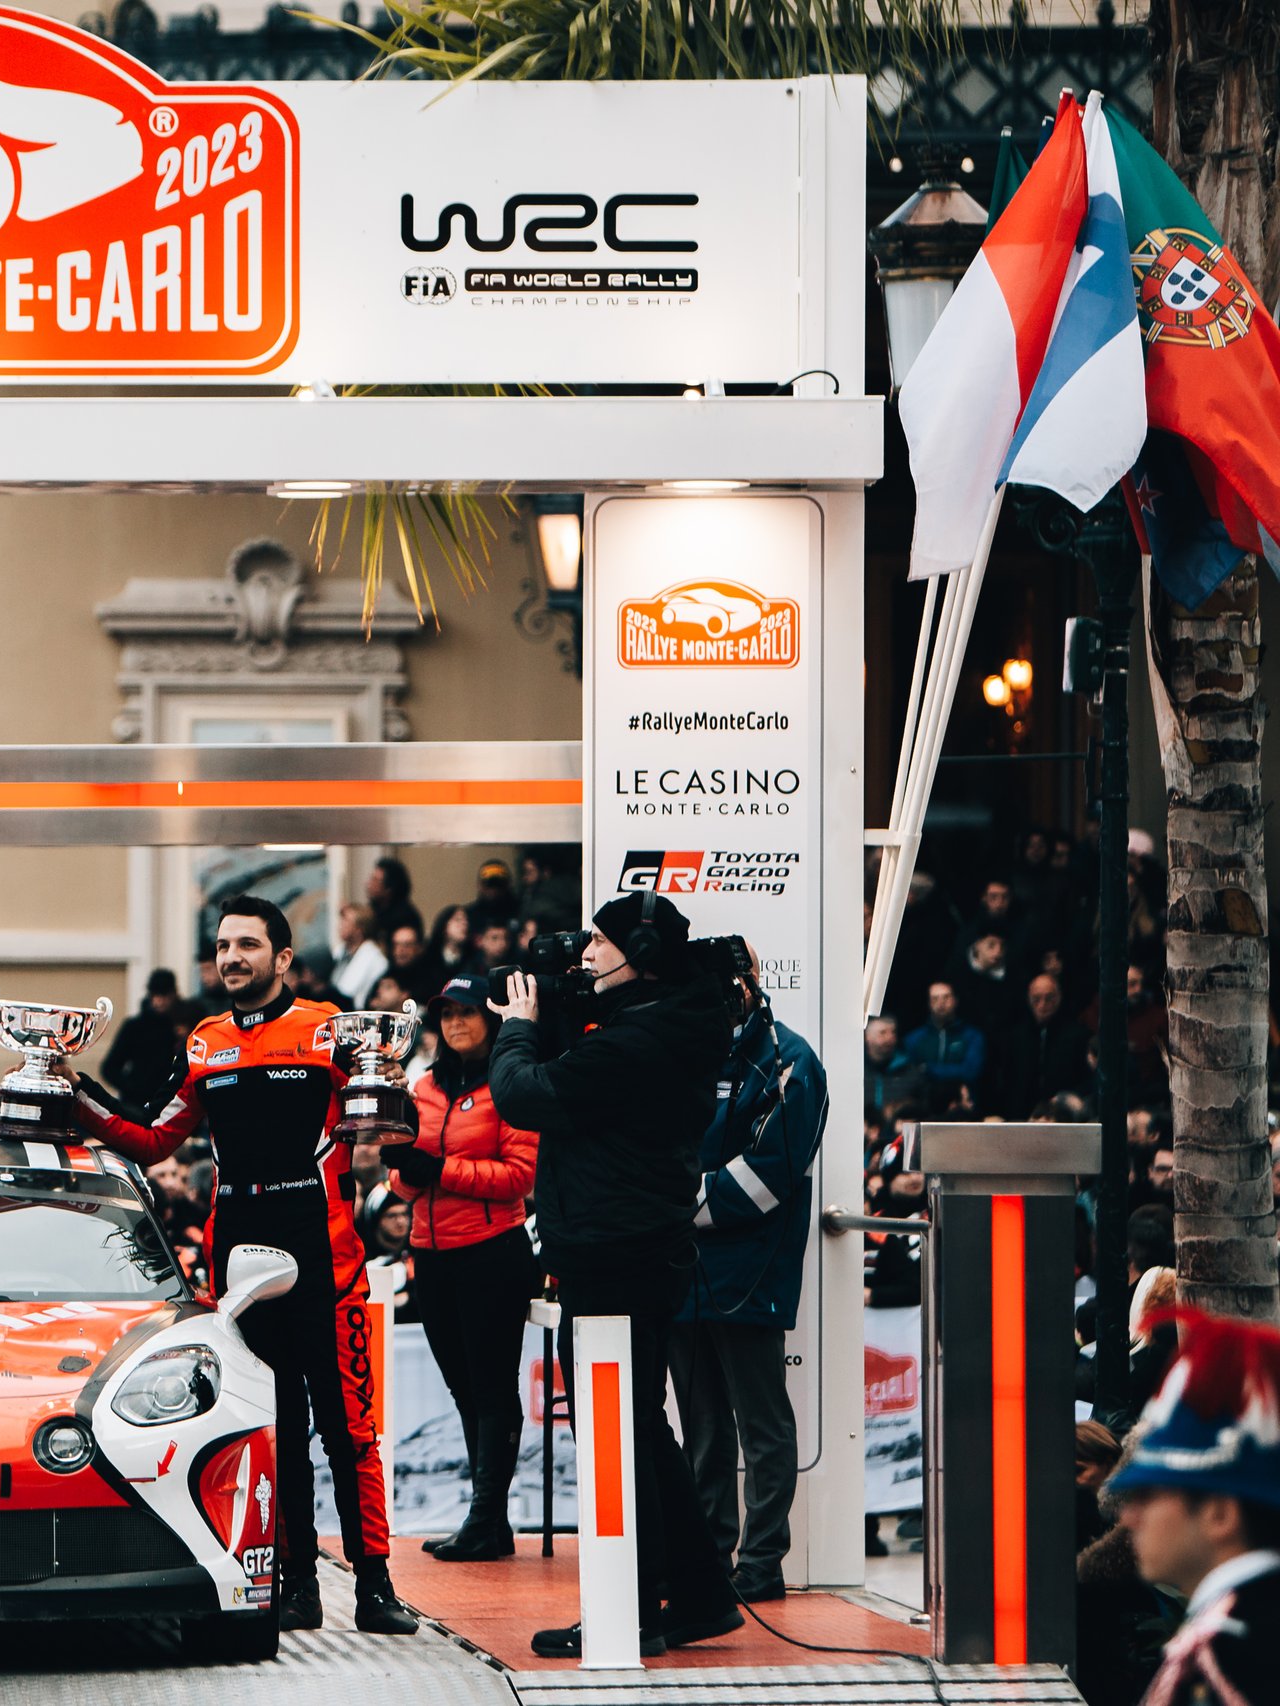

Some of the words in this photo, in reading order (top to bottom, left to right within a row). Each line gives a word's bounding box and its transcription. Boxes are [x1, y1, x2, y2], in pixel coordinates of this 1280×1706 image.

[155, 111, 263, 212] 2023
[401, 193, 699, 252] WRC
[470, 273, 507, 287] FIA
[513, 273, 600, 287] WORLD
[607, 273, 693, 287] RALLY
[471, 296, 691, 306] CHAMPIONSHIP
[626, 608, 657, 634] 2023
[760, 608, 791, 634] 2023
[626, 623, 677, 661] RALLYE
[682, 623, 791, 661] MONTE-CARLO
[628, 711, 789, 734] #RallyeMonteCarlo
[616, 770, 649, 795] LE
[659, 769, 800, 795] CASINO
[710, 851, 800, 863] TOYOTA
[621, 866, 698, 892] GR
[706, 865, 790, 878] GAZOO
[703, 880, 786, 896] Racing
[760, 959, 801, 976] IQUE
[266, 1069, 308, 1079] YACCO
[347, 1306, 374, 1420] YACCO
[784, 1355, 803, 1366] co
[242, 1546, 274, 1575] GT2
